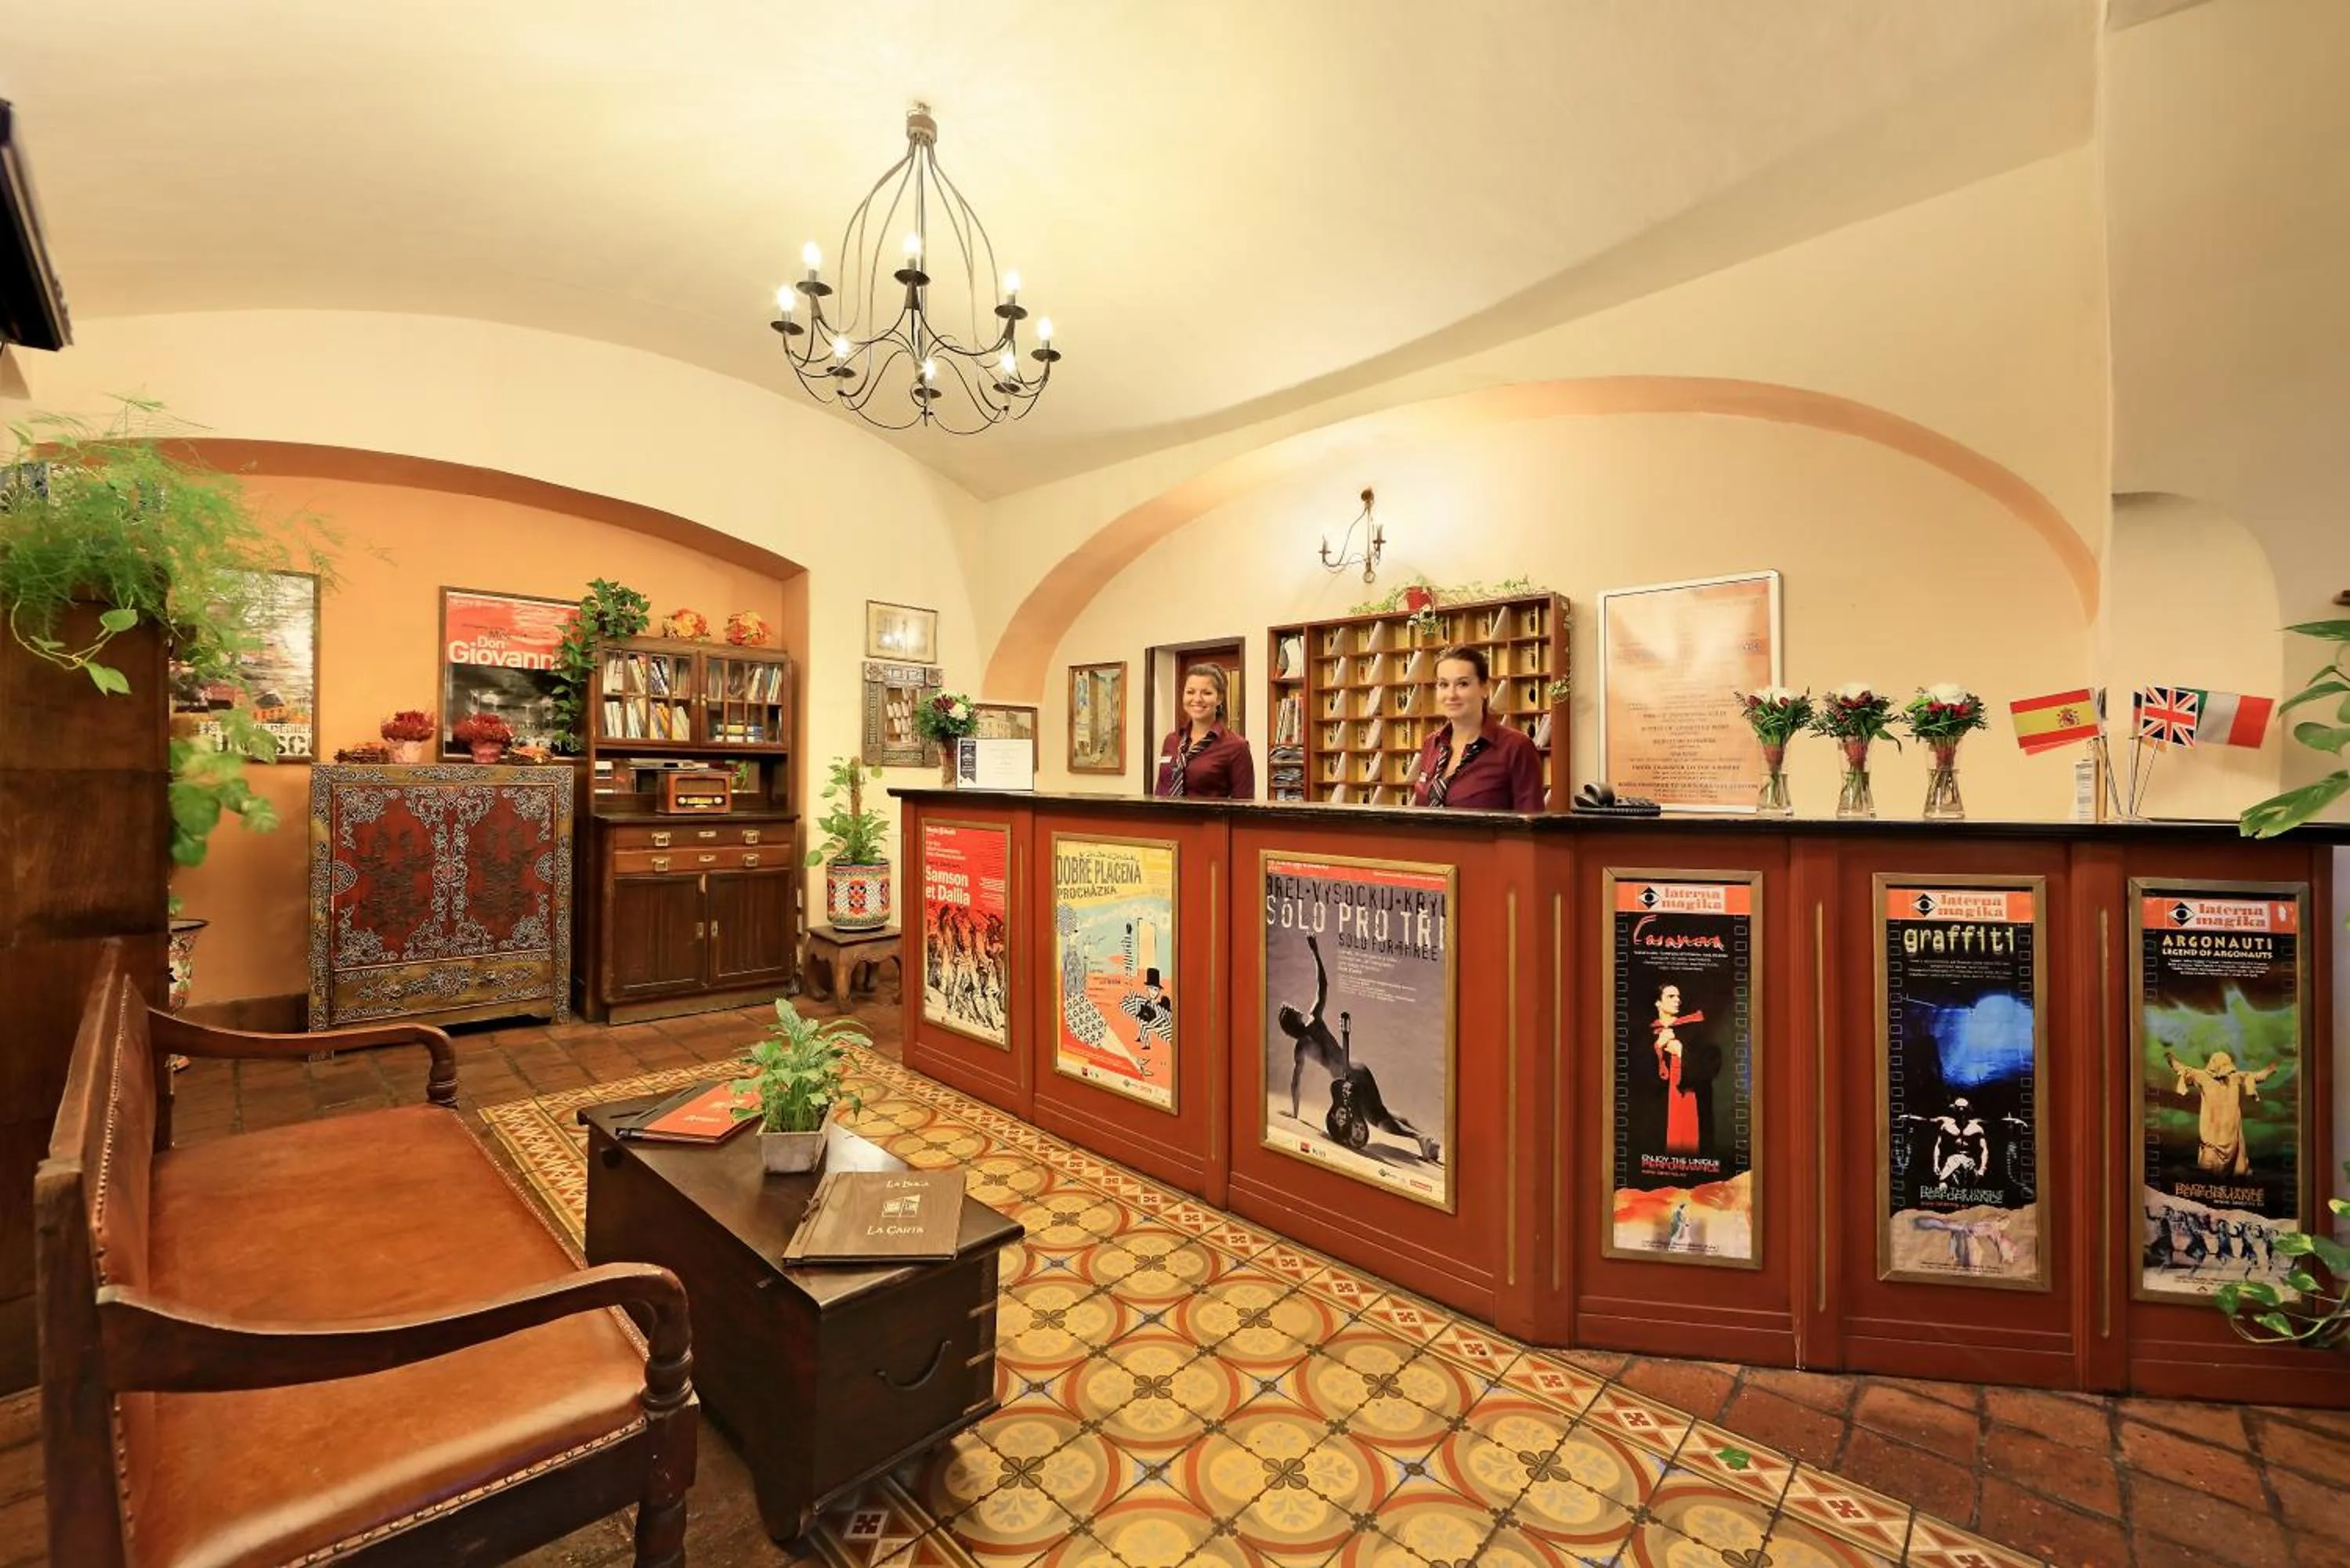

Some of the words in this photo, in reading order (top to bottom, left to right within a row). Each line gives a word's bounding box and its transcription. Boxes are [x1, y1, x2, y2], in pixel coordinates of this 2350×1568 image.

[477, 635, 505, 649] Don
[448, 640, 562, 670] Giovann
[926, 865, 969, 887] Samson
[926, 883, 935, 900] et
[938, 884, 971, 906] Dalila
[1339, 901, 1389, 941] PRO
[1339, 932, 1368, 950] SOLO
[1372, 936, 1394, 955] FOR
[1904, 924, 2015, 954] graffiti
[2162, 934, 2273, 949] ARGONAUTI
[2199, 948, 2212, 957] OF
[2213, 949, 2273, 959] ARGONAUTS
